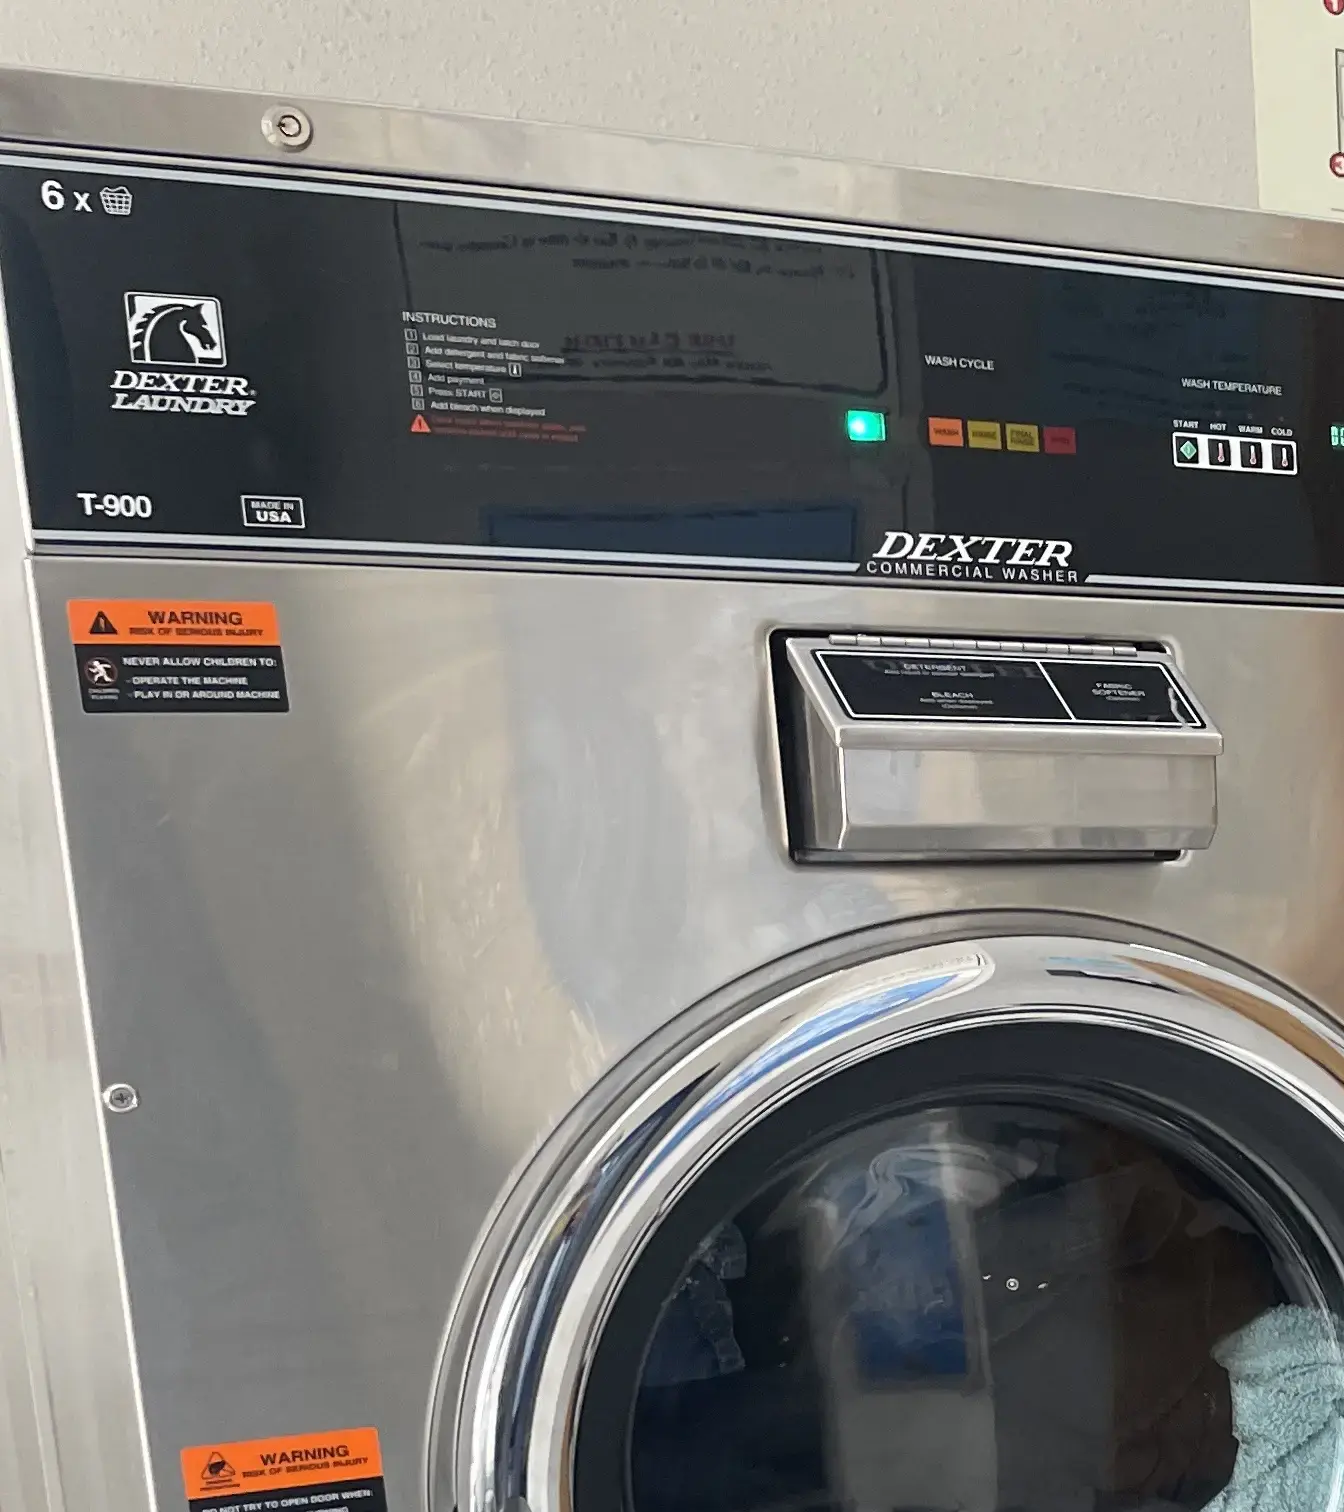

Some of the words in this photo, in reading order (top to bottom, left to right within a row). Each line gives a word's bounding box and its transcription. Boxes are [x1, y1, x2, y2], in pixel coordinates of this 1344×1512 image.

[41, 180, 65, 210] 6
[74, 191, 93, 213] x
[402, 311, 497, 328] INSTRUCTIONS
[425, 346, 442, 355] Add
[924, 354, 957, 368] WASH
[959, 357, 994, 371] CYCLE
[110, 370, 249, 396] DEXTER
[428, 374, 445, 383] Add
[455, 388, 486, 399] START
[1181, 378, 1210, 390] WASH
[1212, 380, 1282, 396] TEMPERATURE
[111, 393, 256, 416] LAUNDRY
[431, 401, 448, 410] Add
[1173, 419, 1199, 429] START
[1210, 422, 1226, 431] HOT
[1238, 425, 1263, 435] WARM
[1271, 427, 1292, 437] COLD
[77, 493, 152, 518] T-900
[251, 501, 278, 511] MADE
[282, 502, 294, 511] IN
[256, 511, 292, 523] USA
[872, 530, 1073, 568] DEXTER
[866, 560, 993, 579] COMMERCIAL
[1002, 567, 1078, 583] WASHER
[148, 611, 243, 624] WARNING
[129, 627, 154, 636] RISK
[158, 628, 172, 636] OF
[123, 657, 160, 667] NEVER
[163, 657, 200, 667] ALLOW
[203, 657, 257, 667] CHILDREN
[132, 676, 179, 686] OPERATE
[182, 677, 200, 686] THE
[203, 677, 248, 686] MACHINE
[134, 690, 160, 700] PLAY
[175, 691, 190, 700] OR
[192, 691, 234, 700] AROUND
[236, 691, 280, 700] MACHINE
[260, 1445, 349, 1466] WARNING
[269, 1467, 281, 1476] OF
[242, 1502, 263, 1512] TRY
[264, 1500, 279, 1509] TO
[281, 1496, 308, 1507] OPEN
[310, 1493, 339, 1504] DOOR
